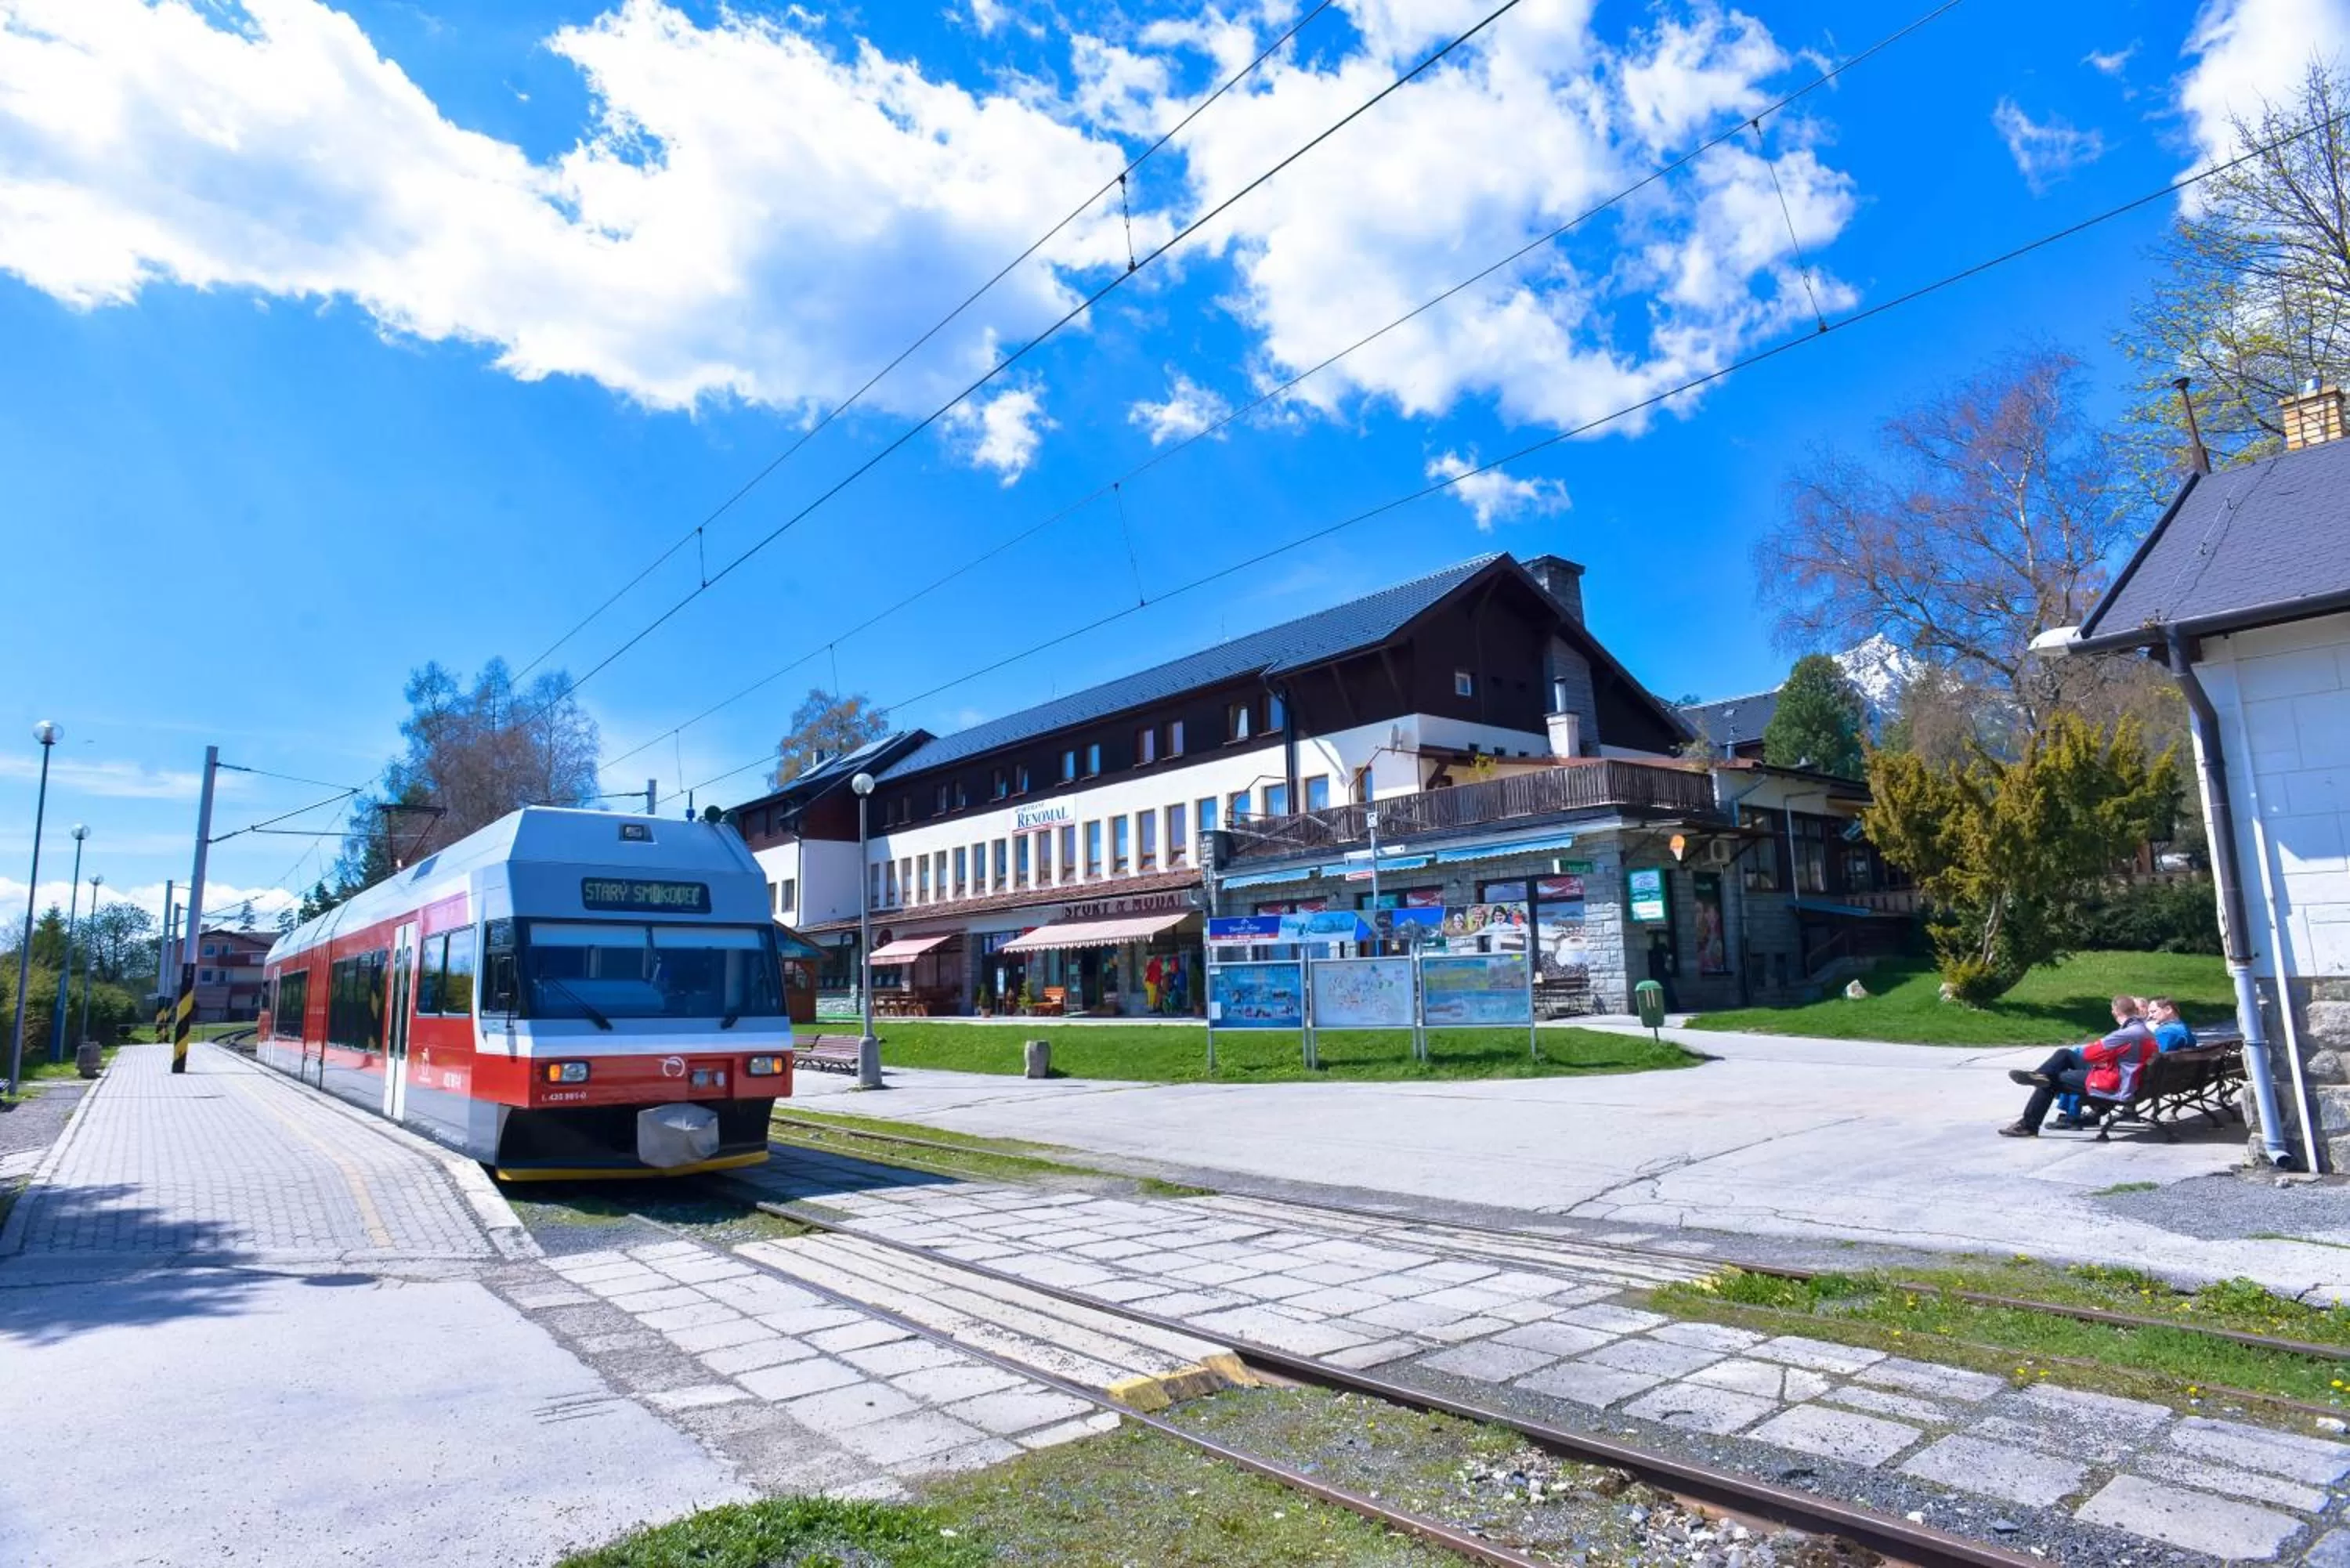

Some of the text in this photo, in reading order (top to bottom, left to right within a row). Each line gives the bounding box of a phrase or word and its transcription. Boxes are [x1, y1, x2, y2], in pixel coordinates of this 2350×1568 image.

[1018, 806, 1070, 827] RENOMAL
[633, 883, 700, 905] SMOKOVEC
[1065, 901, 1109, 917] SPORT
[1132, 894, 1175, 912] MODA
